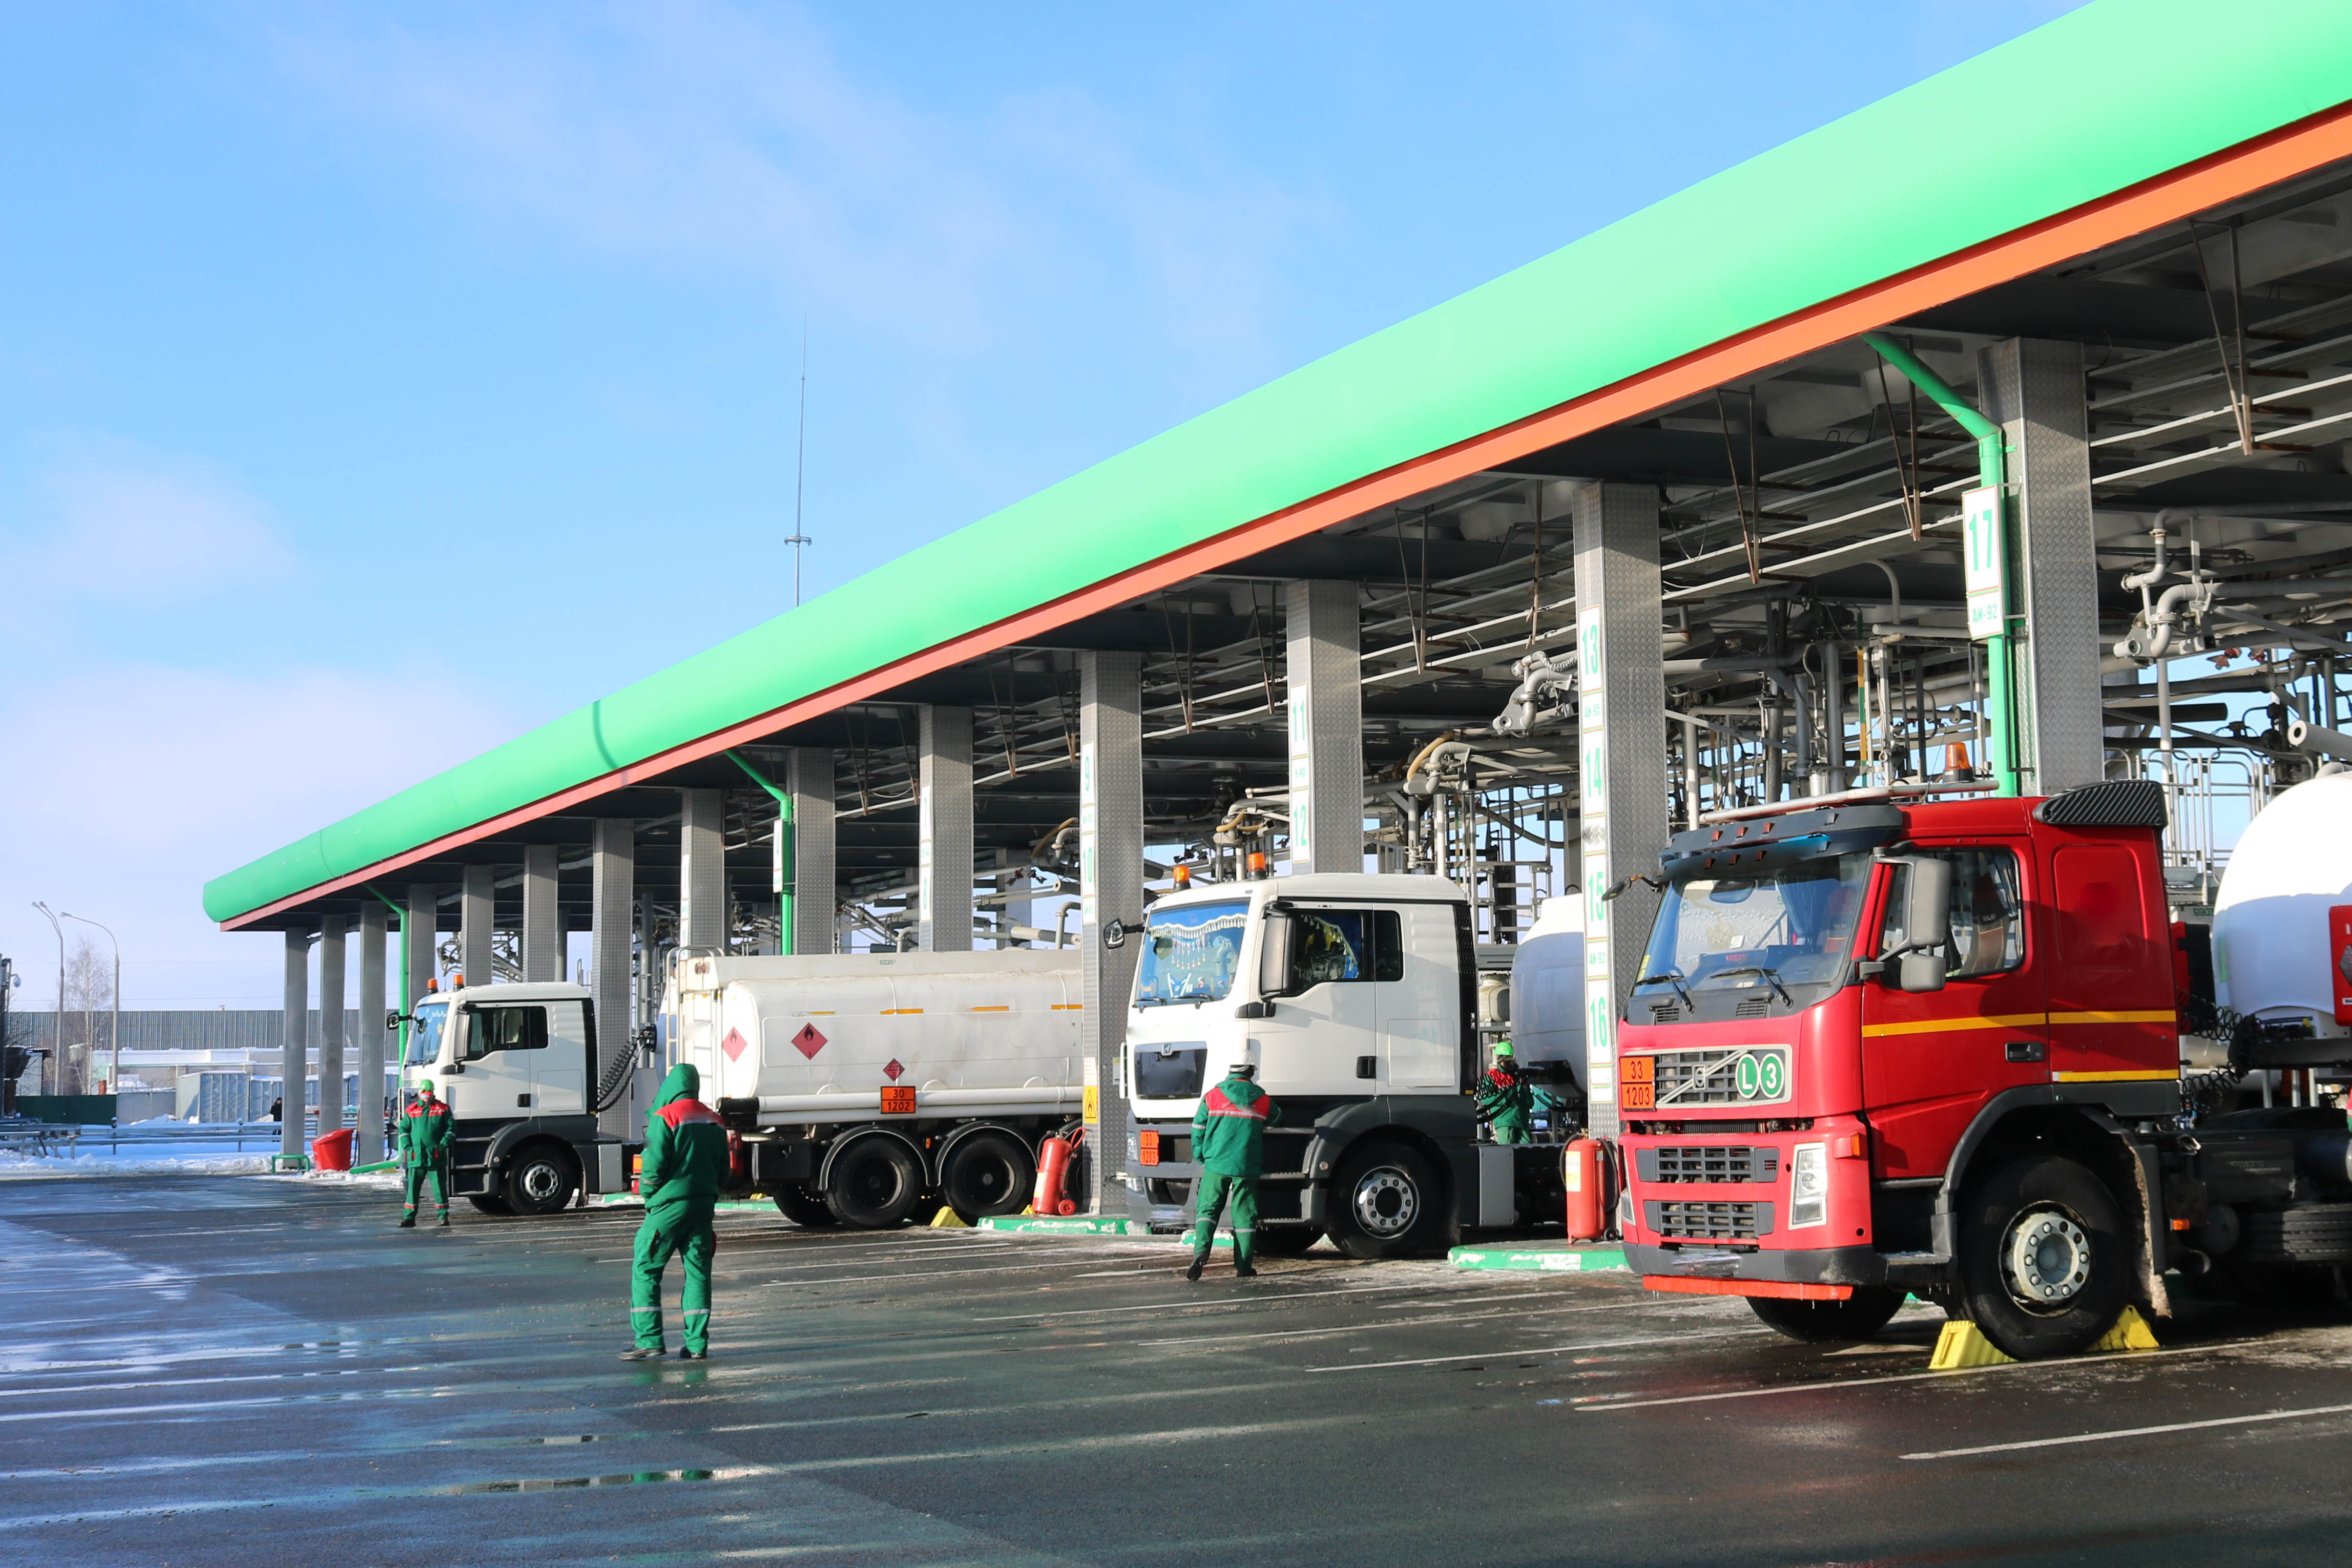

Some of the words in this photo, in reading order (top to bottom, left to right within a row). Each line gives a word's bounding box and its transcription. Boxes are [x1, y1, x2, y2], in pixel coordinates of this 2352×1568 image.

[1969, 509, 1992, 571] 17
[1582, 624, 1598, 675] 13
[1293, 700, 1305, 742] 11
[1085, 756, 1090, 791] 9
[1586, 747, 1602, 797] 14
[1294, 804, 1307, 846] 12
[1083, 847, 1092, 884] 10
[1588, 872, 1604, 922] 15
[1590, 997, 1607, 1047] 16
[1631, 1060, 1642, 1079] 33
[1742, 1063, 1752, 1090] L
[1766, 1062, 1777, 1090] 3
[887, 1101, 910, 1111] 1202
[893, 1089, 904, 1098] 30
[1627, 1086, 1650, 1105] 1203
[1143, 1151, 1155, 1163] 1203
[1146, 1134, 1152, 1146] 33
